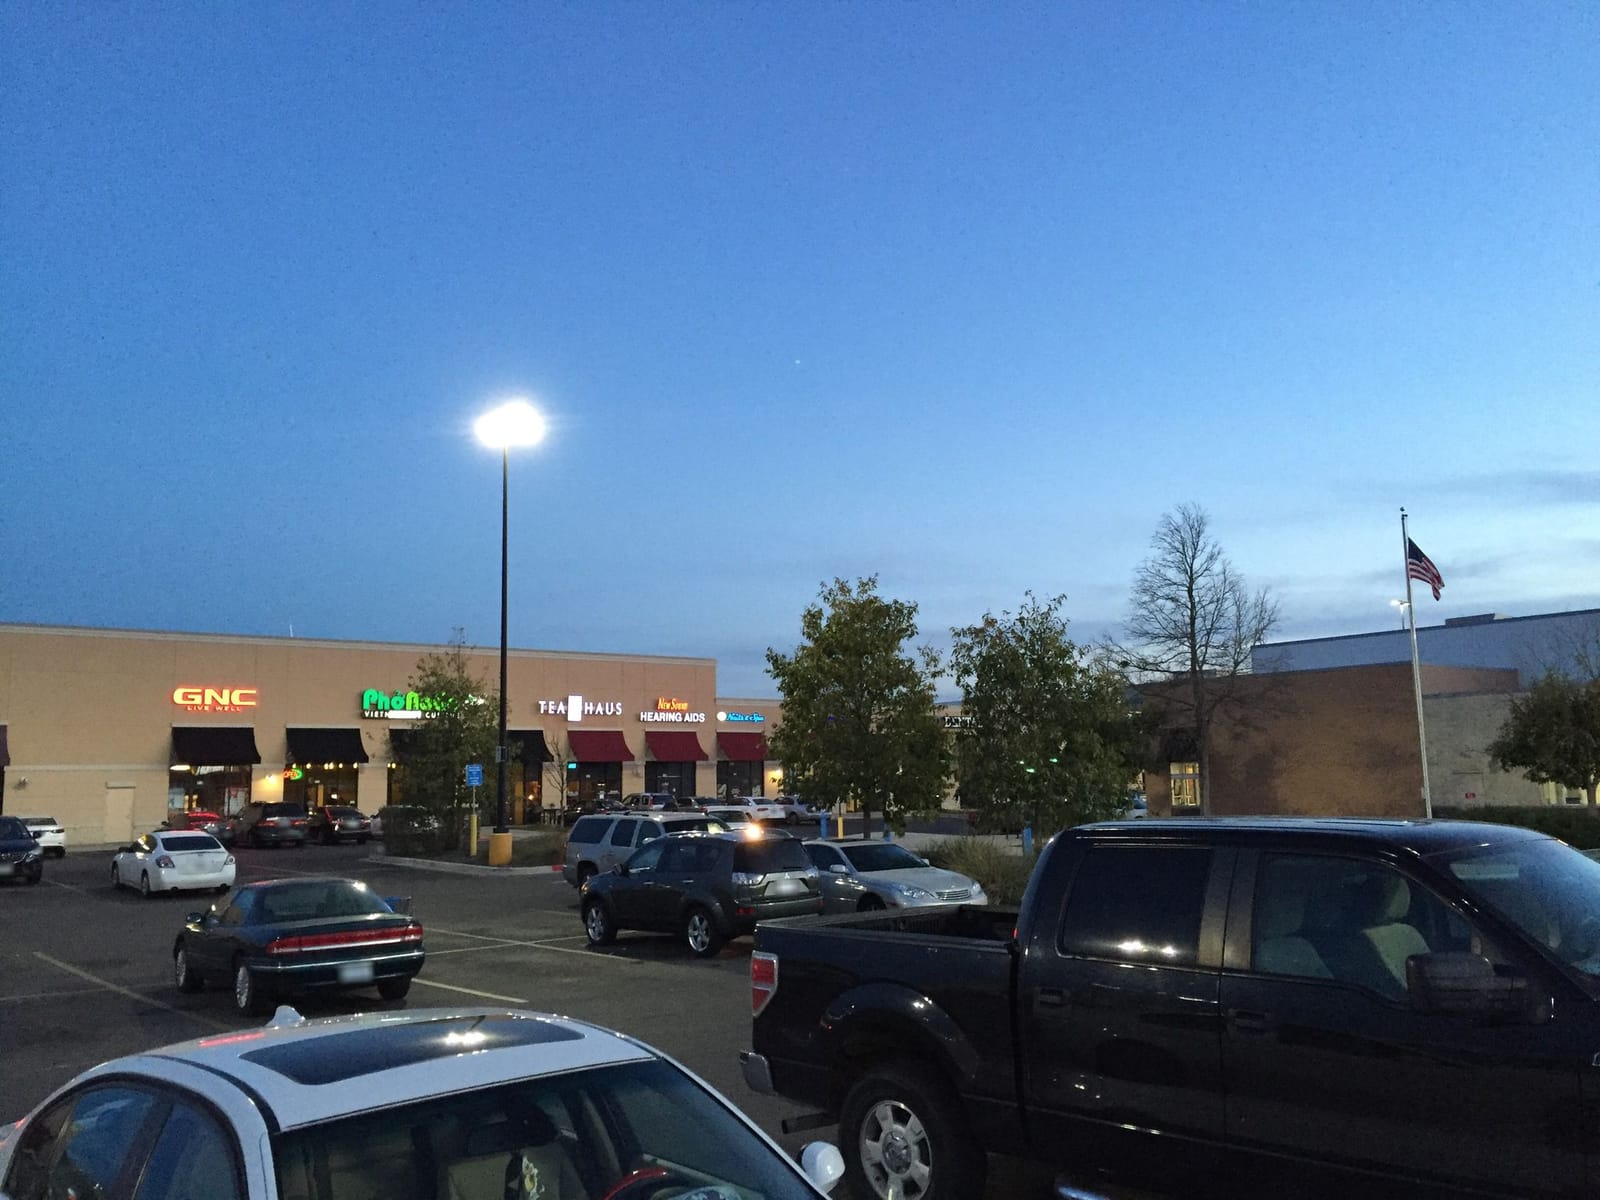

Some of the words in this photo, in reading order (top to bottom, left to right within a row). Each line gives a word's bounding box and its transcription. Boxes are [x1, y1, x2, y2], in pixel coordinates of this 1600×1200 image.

[173, 688, 257, 706] GNC
[538, 700, 566, 715] TEA
[584, 702, 623, 716] HAUS
[640, 711, 682, 723] HEARING
[684, 712, 706, 723] AIDS
